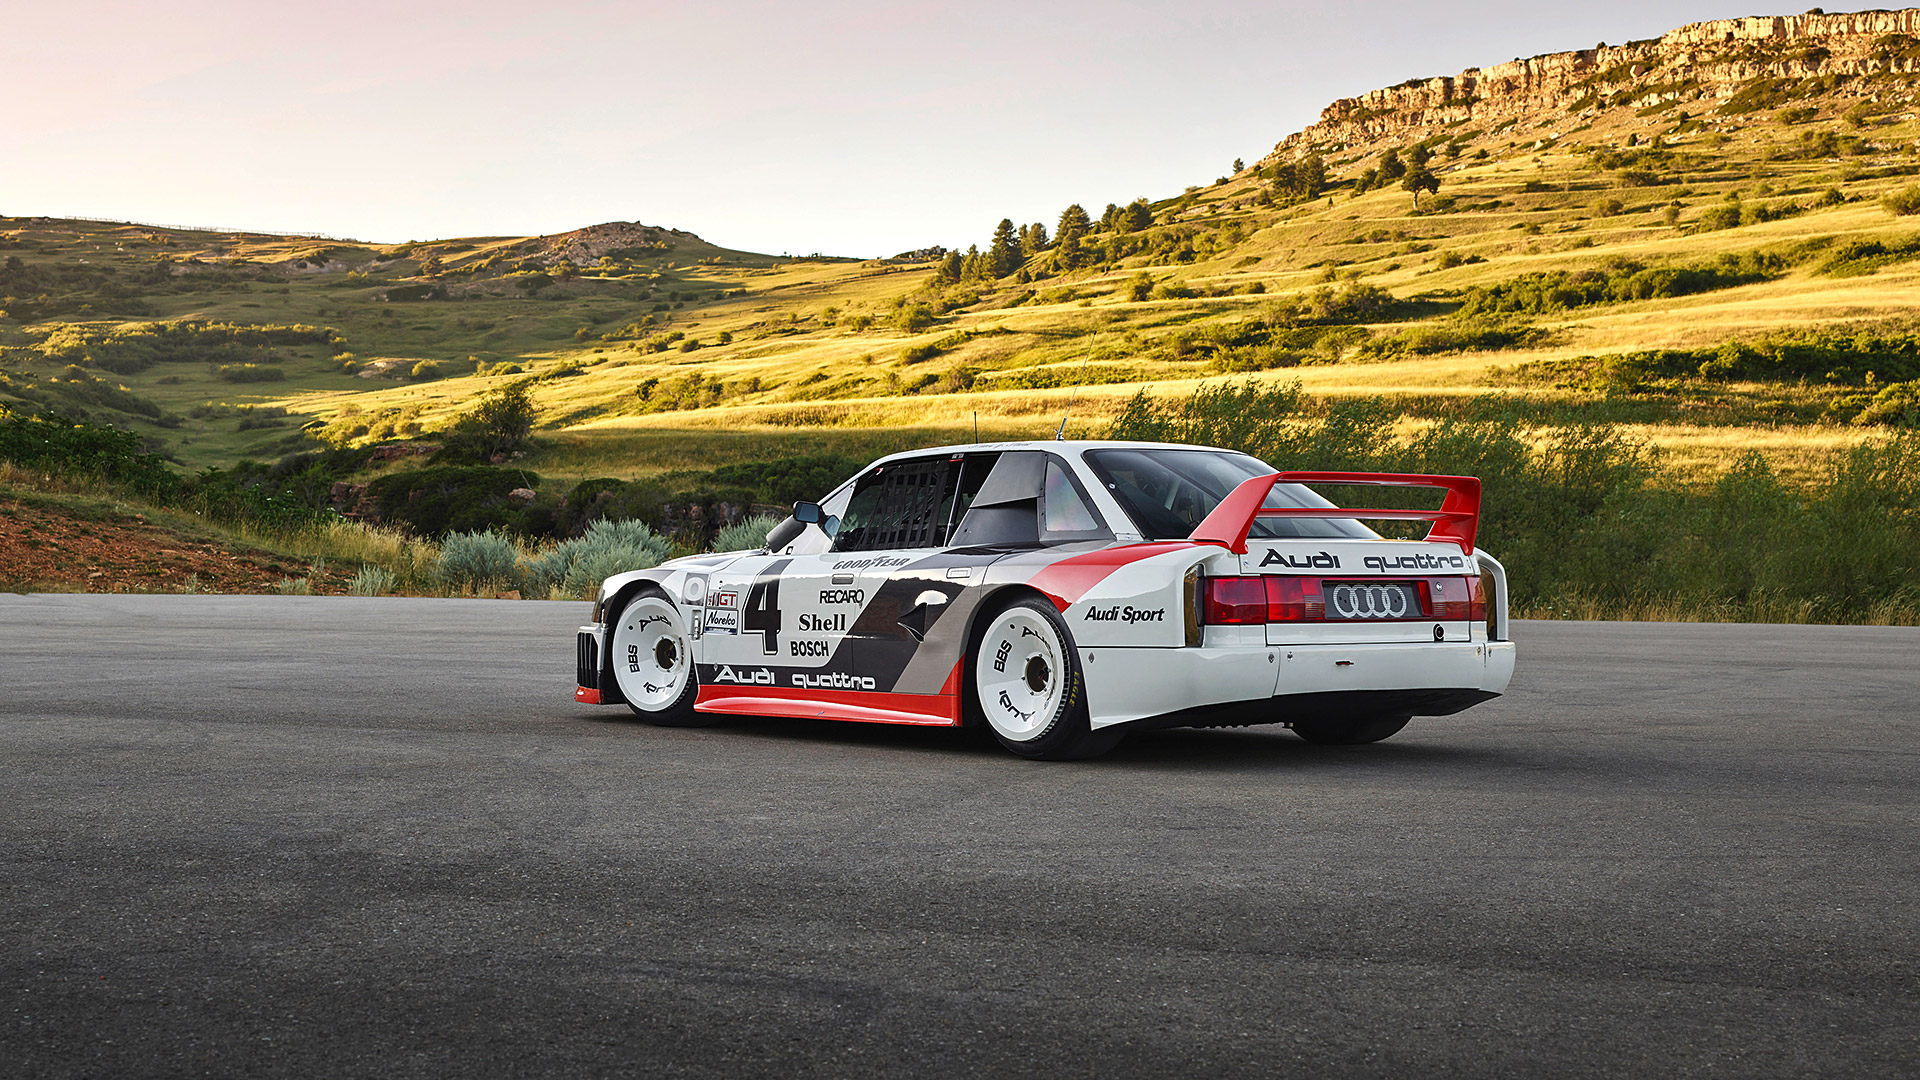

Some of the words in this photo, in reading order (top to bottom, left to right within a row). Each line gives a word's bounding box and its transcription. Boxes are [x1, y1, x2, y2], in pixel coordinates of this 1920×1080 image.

[832, 556, 910, 570] GOODYEAR
[1259, 549, 1341, 569] Audi
[1363, 554, 1463, 573] quattro
[719, 593, 737, 607] GT
[820, 590, 864, 604] RECARO
[705, 611, 736, 626] Norelco
[741, 577, 782, 656] 4
[798, 614, 846, 631] Shell
[1084, 605, 1120, 621] Audi
[1121, 606, 1165, 625] Sport
[628, 644, 640, 673] BBS
[790, 641, 830, 657] BOSCH
[993, 639, 1013, 673] BBS
[713, 665, 776, 685] Audi
[791, 671, 876, 690] quattro
[1068, 671, 1080, 708] EAGLE
